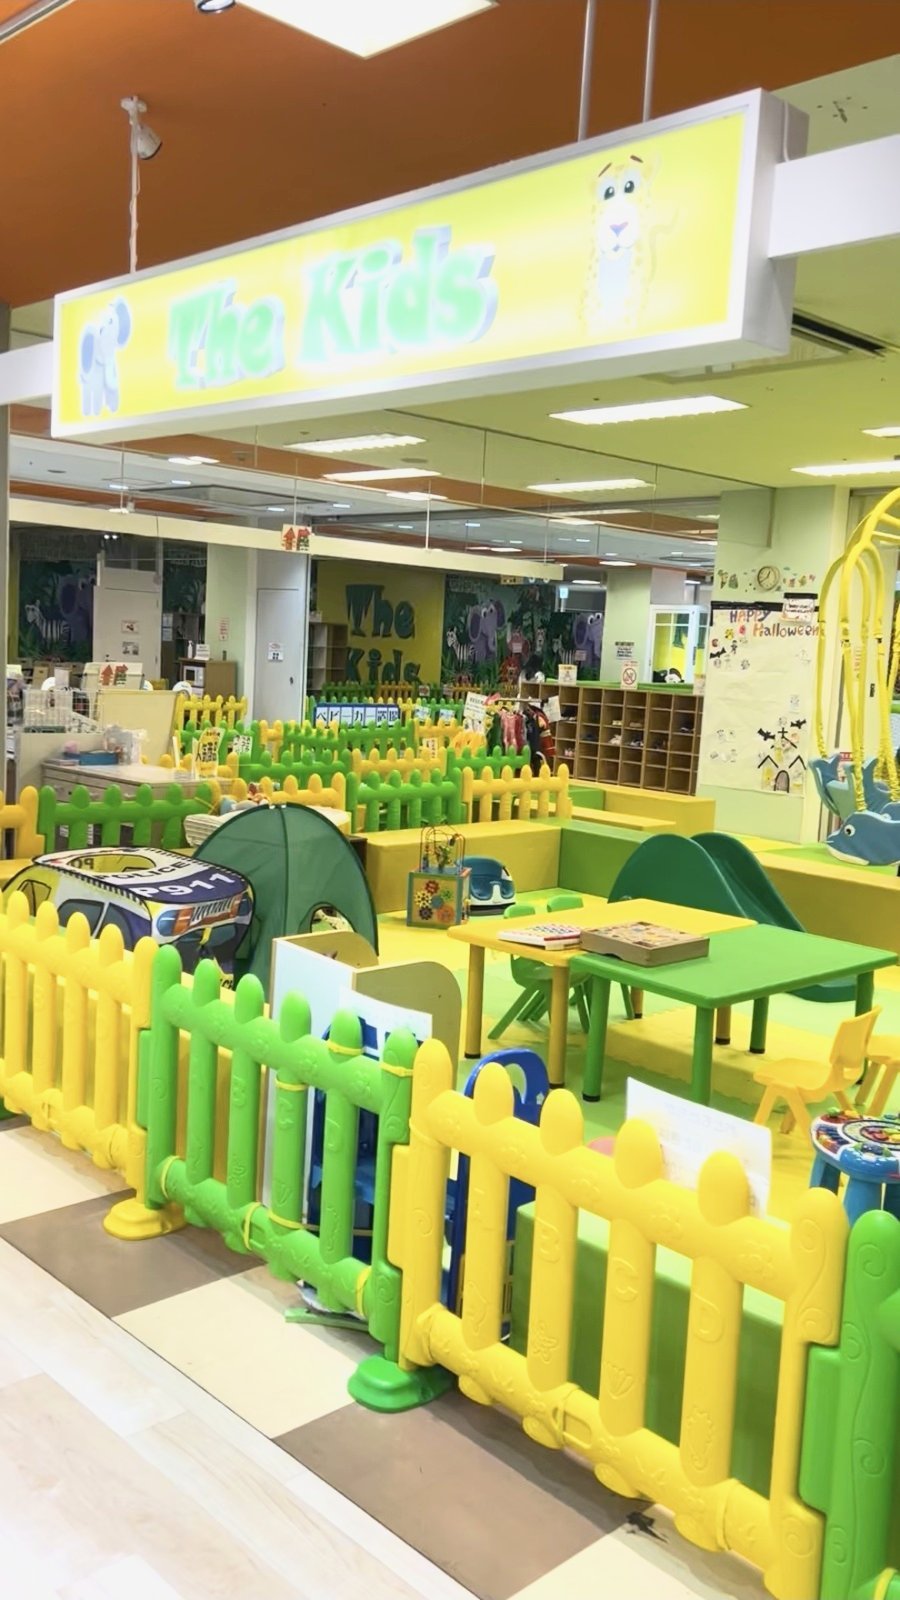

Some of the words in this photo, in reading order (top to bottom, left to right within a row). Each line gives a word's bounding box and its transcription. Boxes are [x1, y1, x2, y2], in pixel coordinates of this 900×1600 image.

[168, 278, 285, 390] The
[296, 224, 498, 365] Kids
[345, 584, 416, 639] The
[753, 622, 820, 637] Halloween
[345, 646, 421, 684] Kids
[96, 861, 191, 880] POLICE
[128, 872, 236, 898] P911
